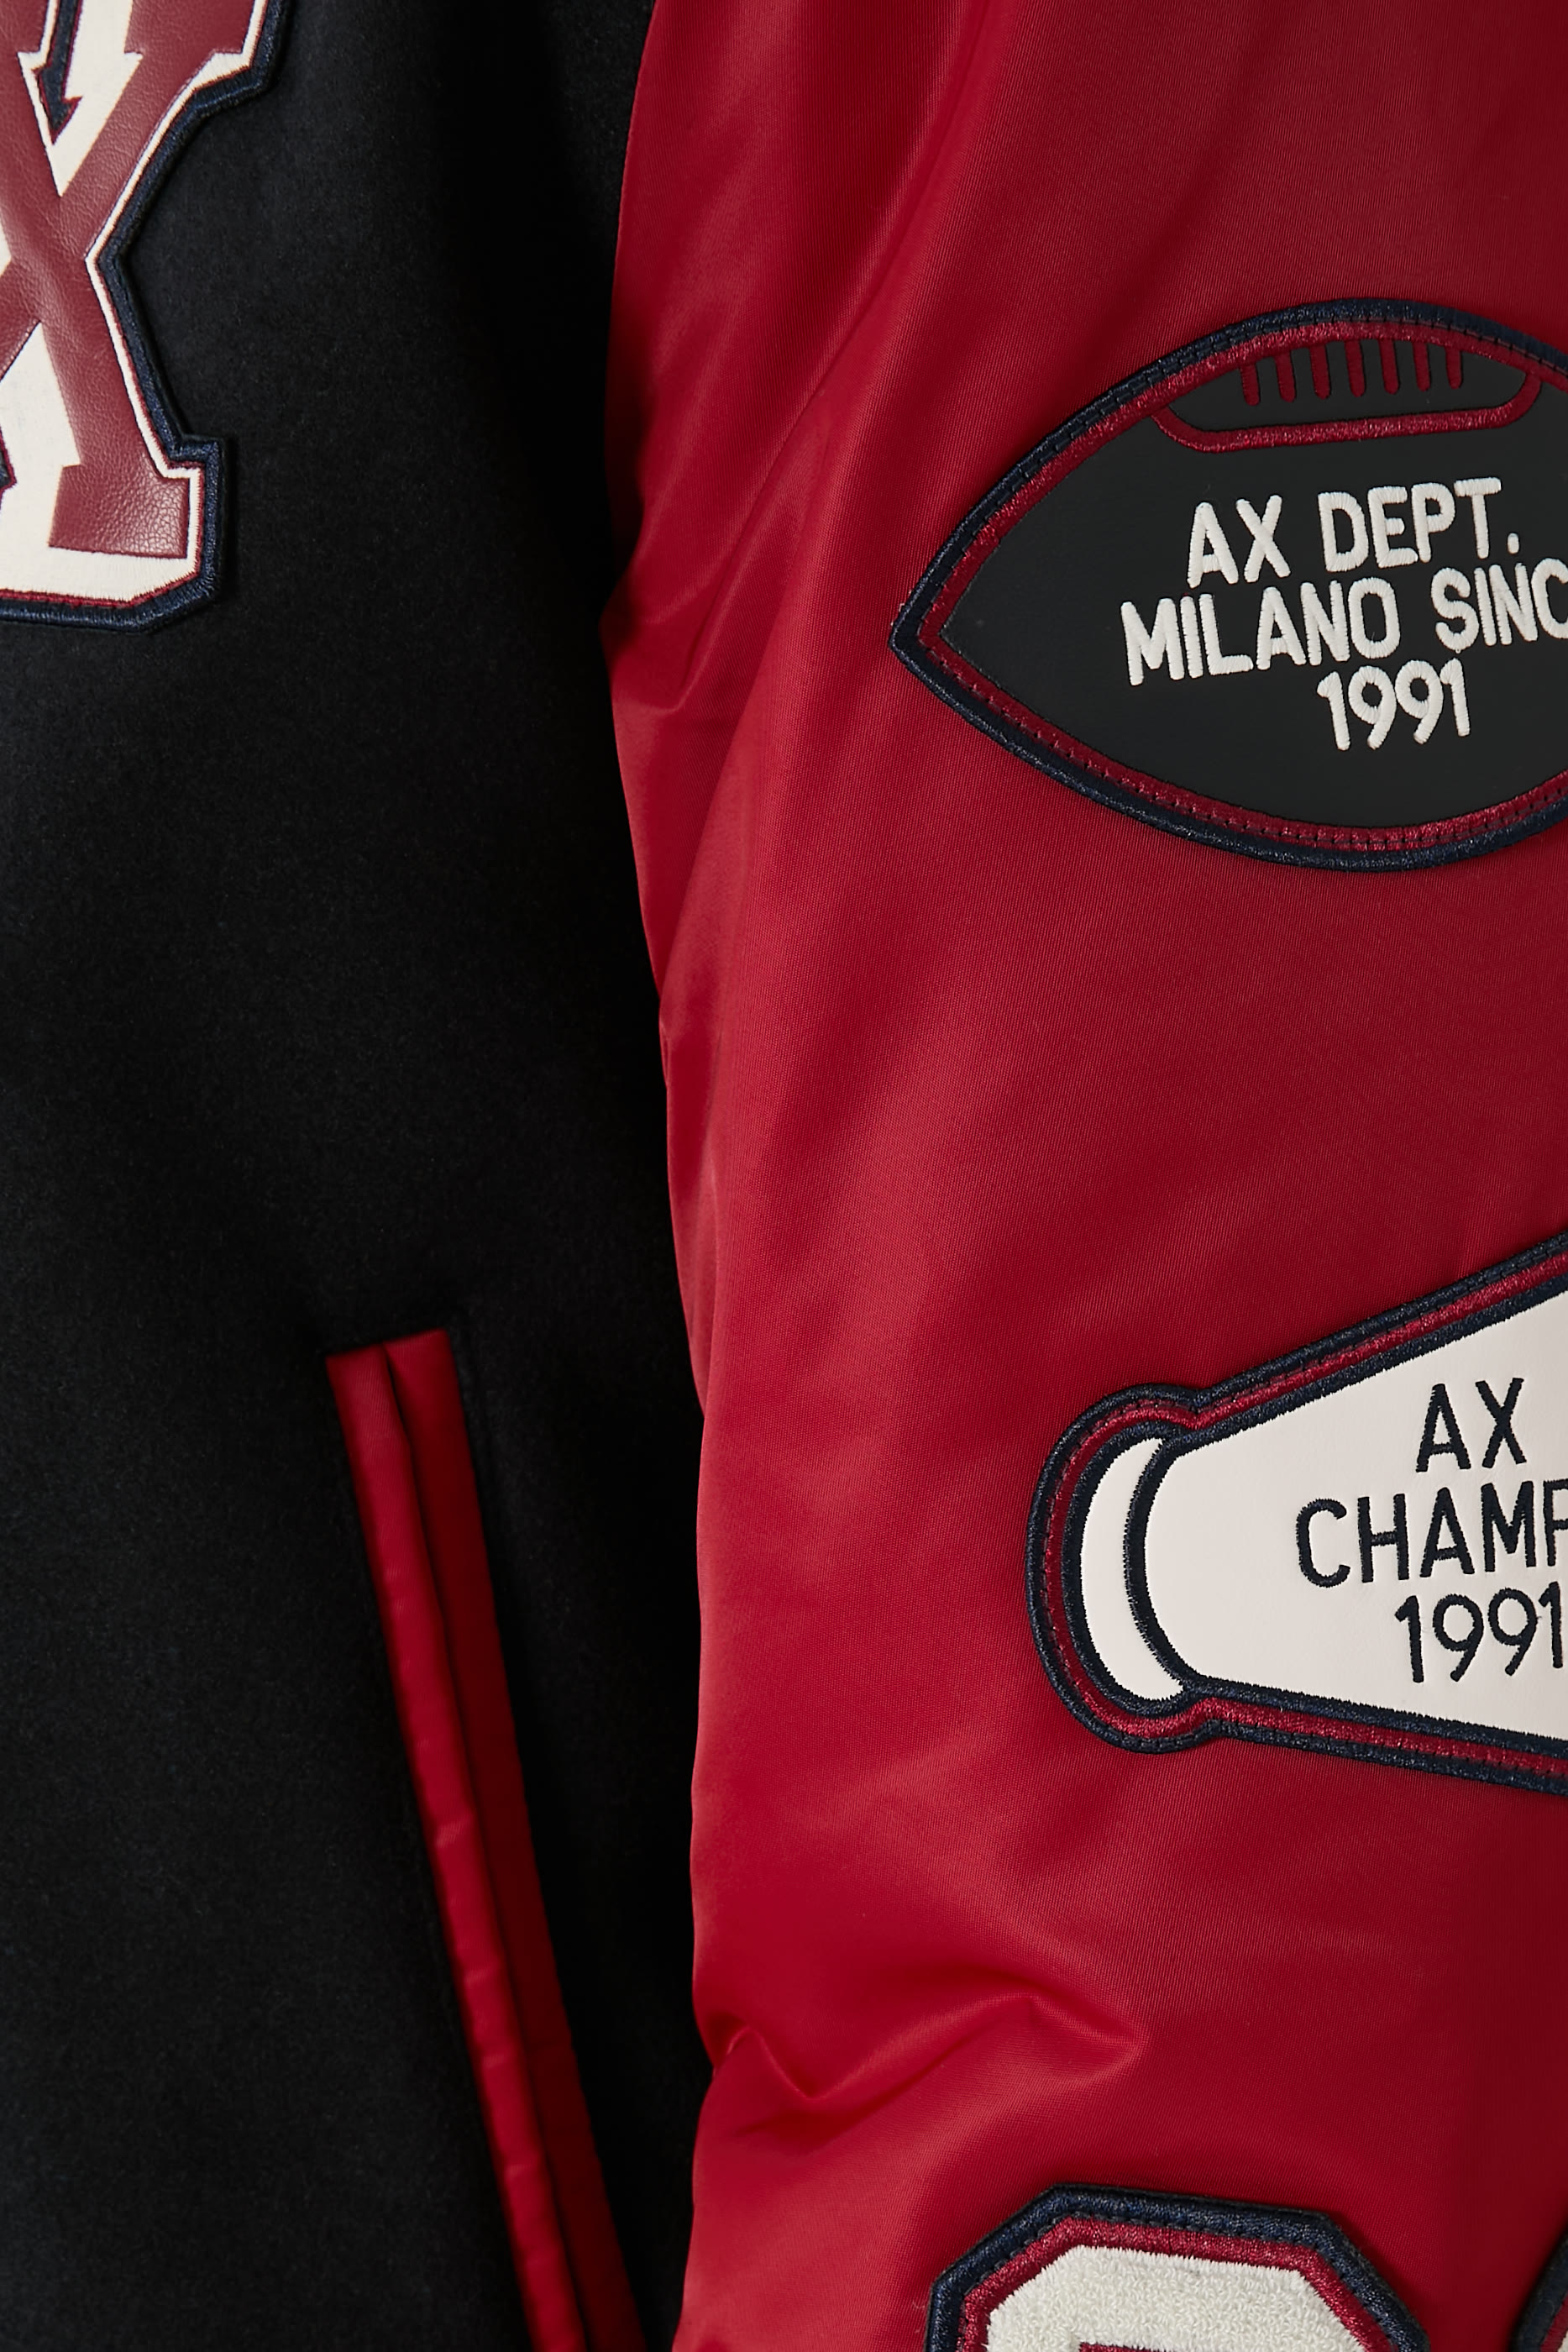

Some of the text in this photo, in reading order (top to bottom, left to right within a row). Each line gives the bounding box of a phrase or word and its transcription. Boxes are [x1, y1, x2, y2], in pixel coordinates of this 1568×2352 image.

[1187, 476, 1519, 589] AX DEPT.
[1120, 576, 1401, 686] MILANO
[1316, 658, 1471, 751] 1991
[1415, 1377, 1528, 1473] AX
[1393, 1581, 1565, 1683] 1991
